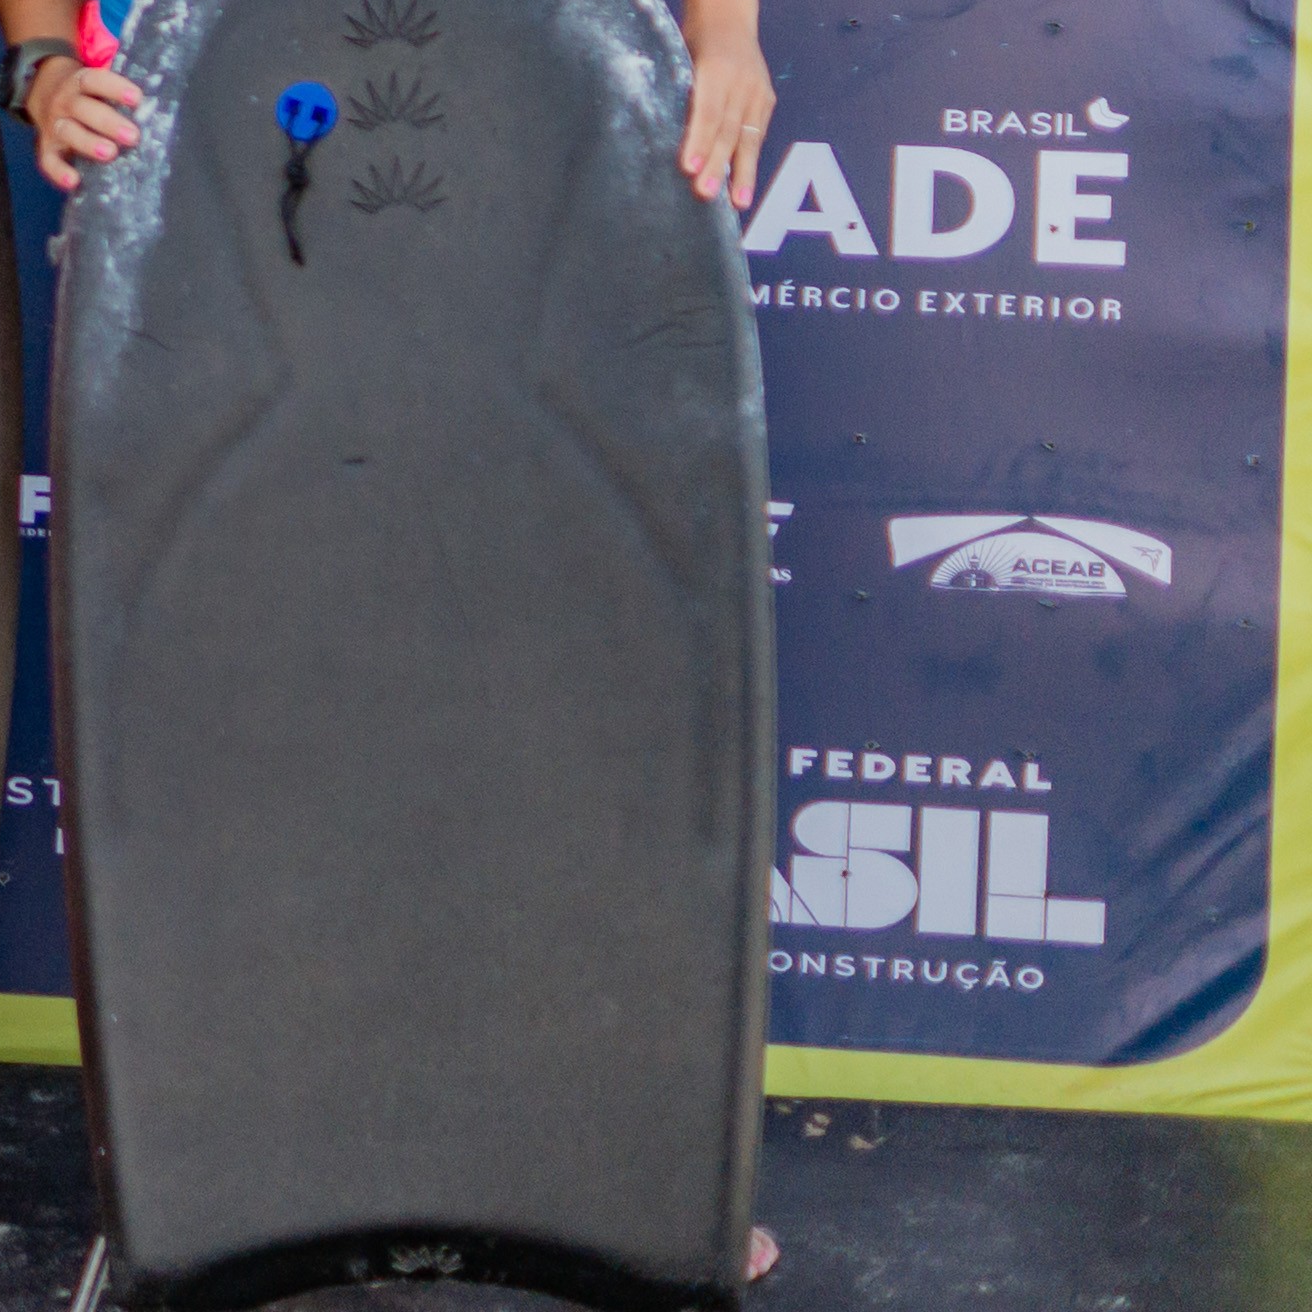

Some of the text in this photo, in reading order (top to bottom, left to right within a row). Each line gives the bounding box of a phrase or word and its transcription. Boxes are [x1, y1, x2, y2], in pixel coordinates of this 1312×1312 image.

[944, 108, 1087, 136] BRASIL
[920, 291, 1123, 321] EXTERIOR
[1012, 557, 1106, 578] ACEAB
[789, 747, 1053, 791] FEDERAL
